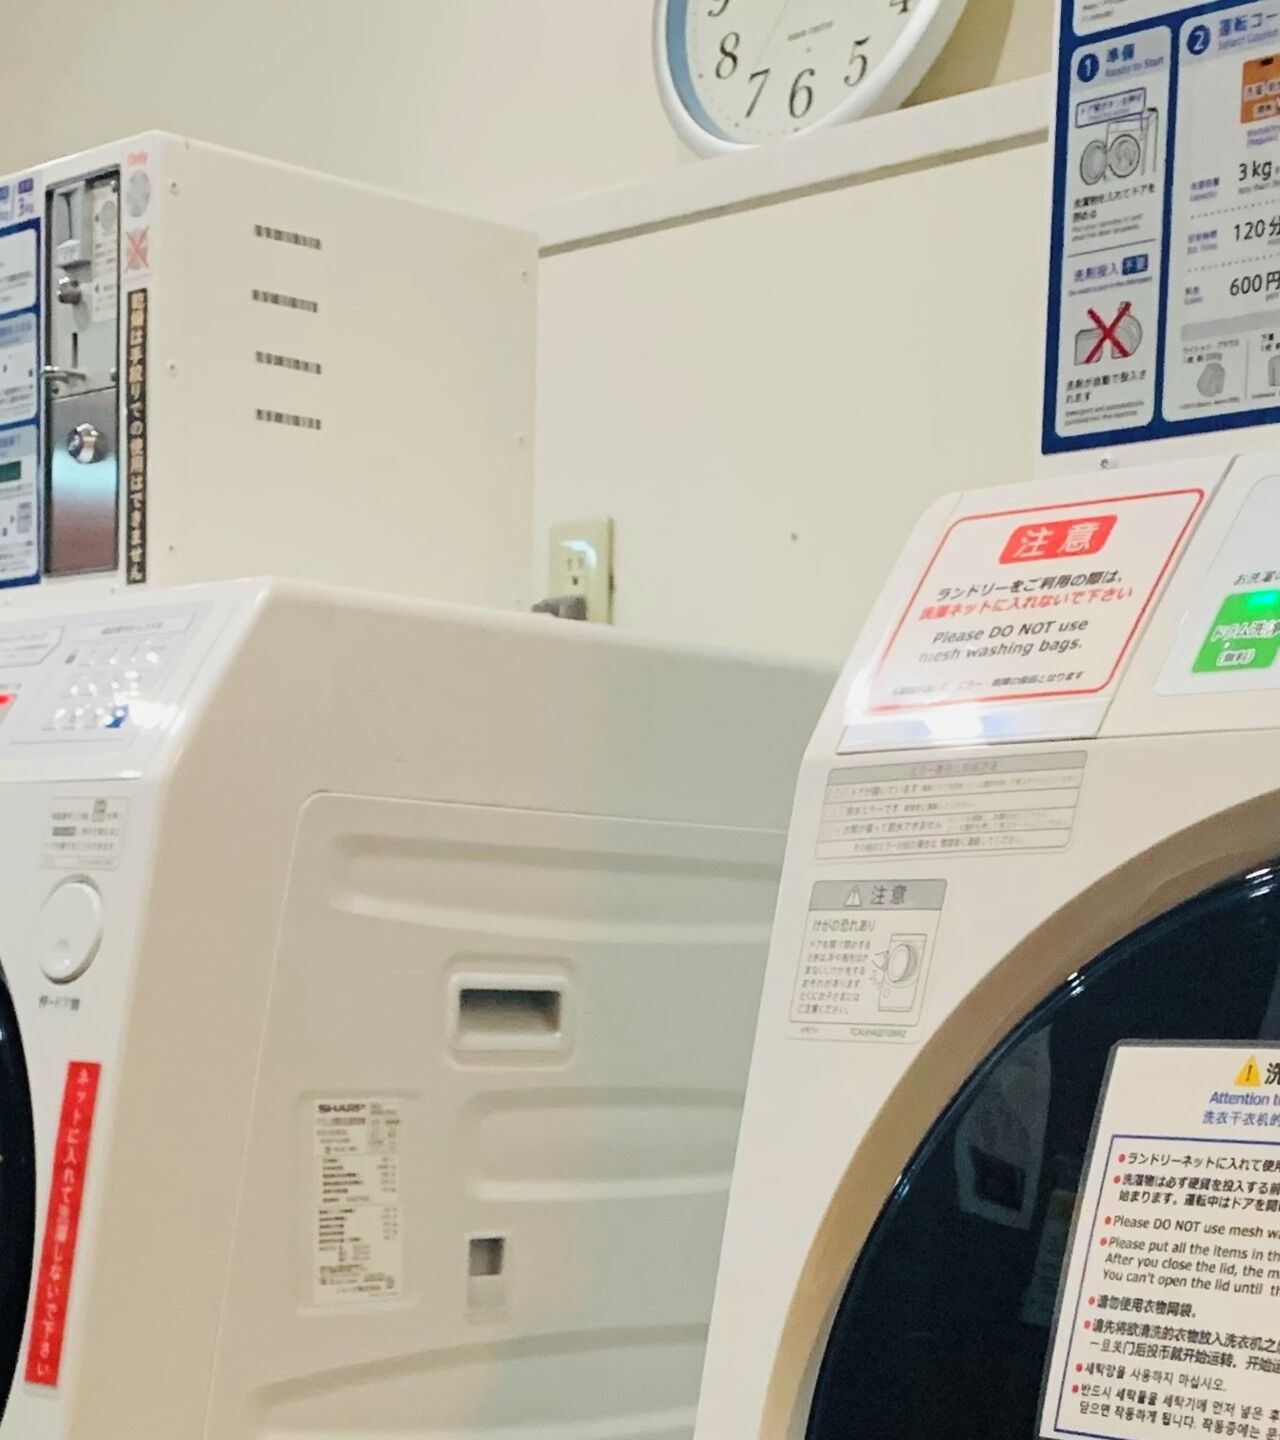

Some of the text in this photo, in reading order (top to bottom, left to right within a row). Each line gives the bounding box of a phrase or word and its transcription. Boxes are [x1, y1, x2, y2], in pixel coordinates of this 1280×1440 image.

[1193, 31, 1204, 51] 2
[714, 31, 741, 80] 8
[843, 35, 871, 87] 5
[1083, 56, 1093, 73] 1
[744, 68, 771, 119] 7
[788, 68, 816, 120] 6
[1012, 521, 1102, 559] 注意
[932, 619, 1089, 644] Please DO NOT use
[965, 641, 1035, 659] washing
[1037, 638, 1083, 654] bags.
[319, 1104, 366, 1113] SHARP
[1209, 1091, 1270, 1106] Attention
[1112, 1215, 1151, 1229] Please
[1152, 1218, 1172, 1231] DO
[1174, 1219, 1202, 1233] NOT
[1203, 1224, 1226, 1235] use
[1228, 1225, 1264, 1238] mesh
[1108, 1236, 1146, 1251] Please
[1147, 1241, 1169, 1254] put
[1171, 1242, 1187, 1254] all
[1189, 1243, 1210, 1257] the
[1213, 1245, 1249, 1260] items
[1251, 1249, 1264, 1261] in
[1104, 1253, 1135, 1266] After
[1137, 1257, 1159, 1269] you
[1161, 1258, 1193, 1271] close
[1195, 1261, 1217, 1274] the
[1219, 1263, 1238, 1277] lid,
[1242, 1265, 1264, 1278] the
